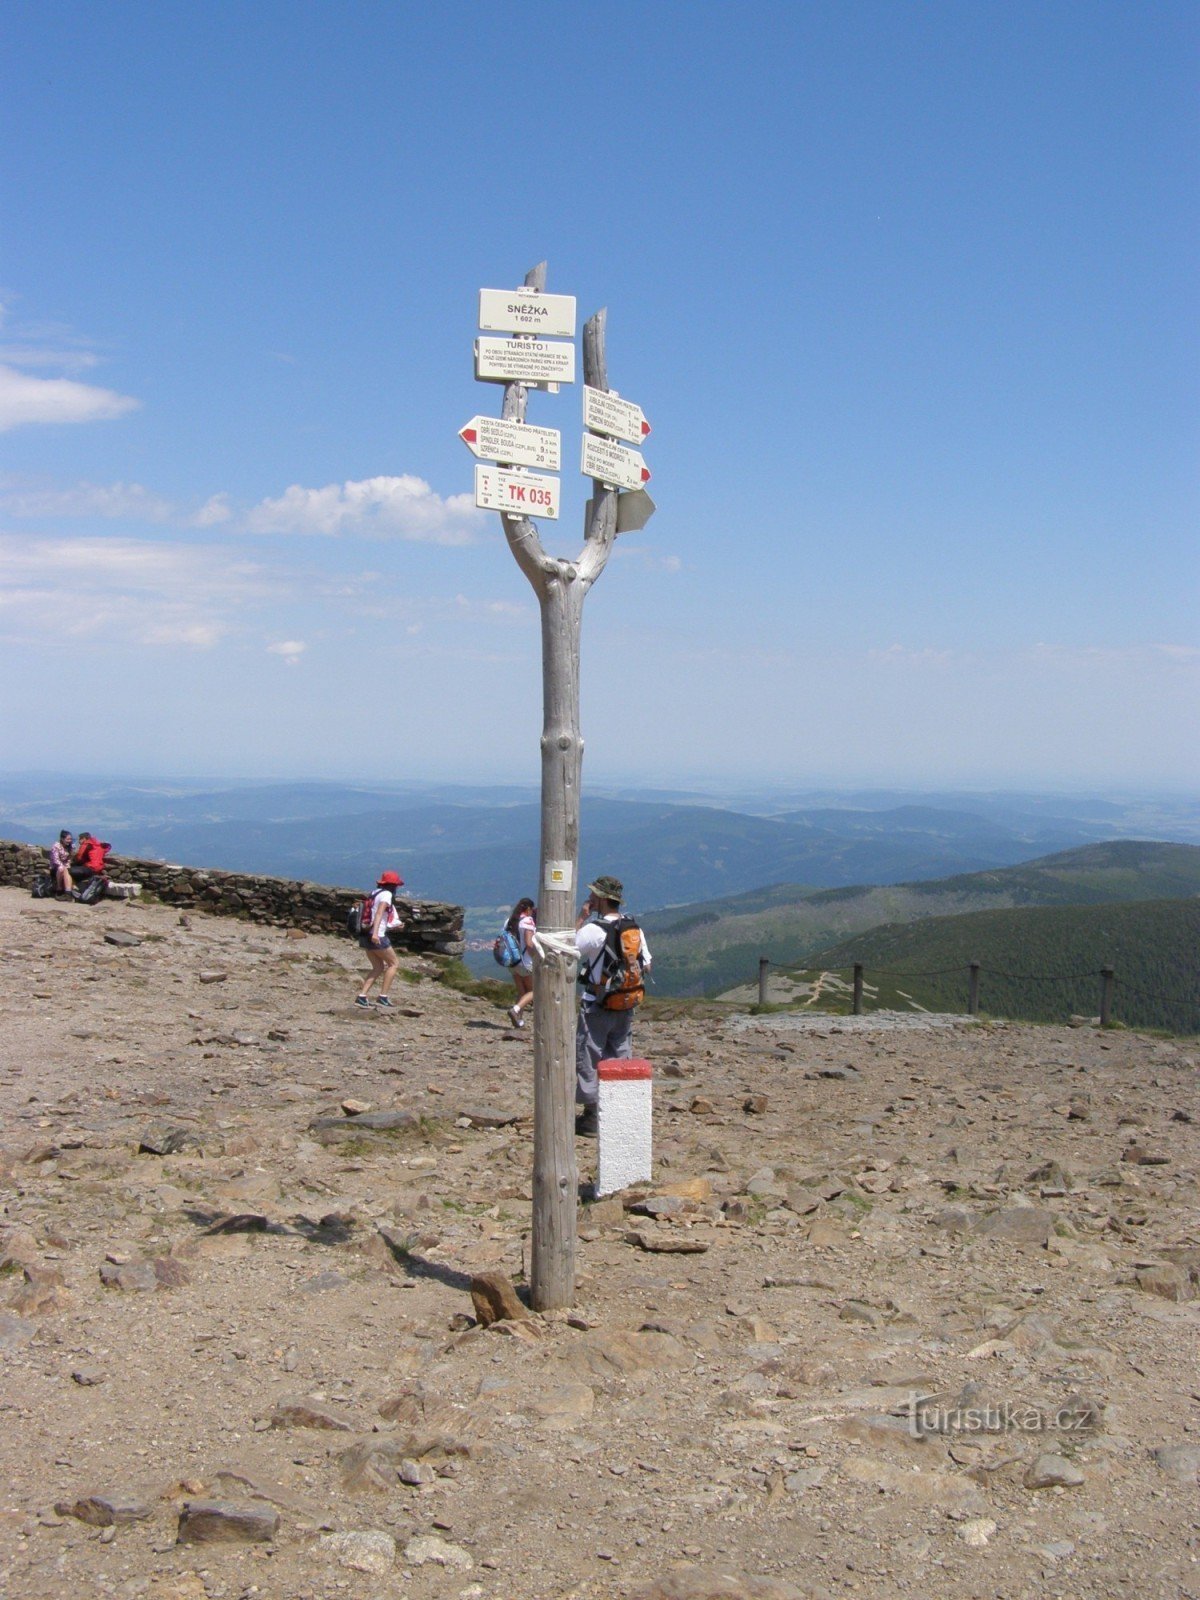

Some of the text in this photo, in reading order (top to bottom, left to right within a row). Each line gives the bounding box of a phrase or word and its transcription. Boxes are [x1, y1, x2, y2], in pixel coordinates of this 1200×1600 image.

[507, 304, 548, 316] SNĚŽKA
[506, 341, 543, 350] TURISTO
[509, 484, 526, 502] TK
[530, 488, 552, 506] 035
